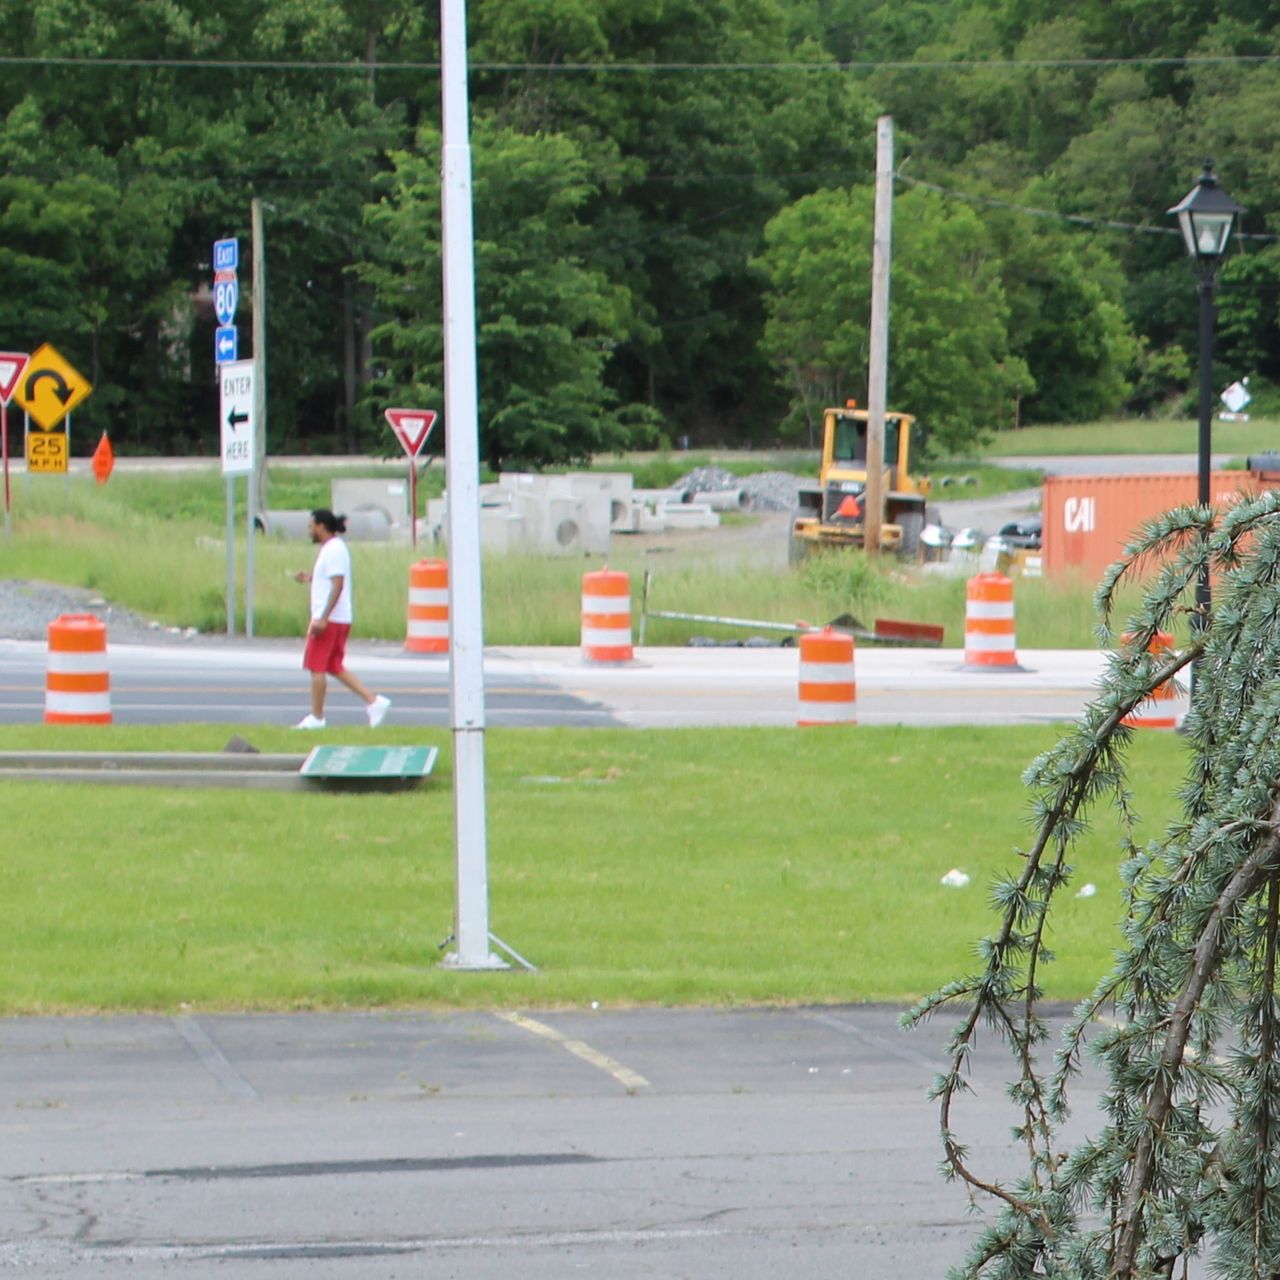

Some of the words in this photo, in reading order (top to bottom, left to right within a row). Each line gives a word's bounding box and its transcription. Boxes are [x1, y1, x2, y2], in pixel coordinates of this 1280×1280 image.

[217, 245, 234, 265] EAST
[217, 283, 235, 317] 80
[224, 376, 251, 397] ENTER
[32, 437, 61, 455] 25
[226, 441, 249, 461] HERE
[1064, 496, 1095, 532] CAI
